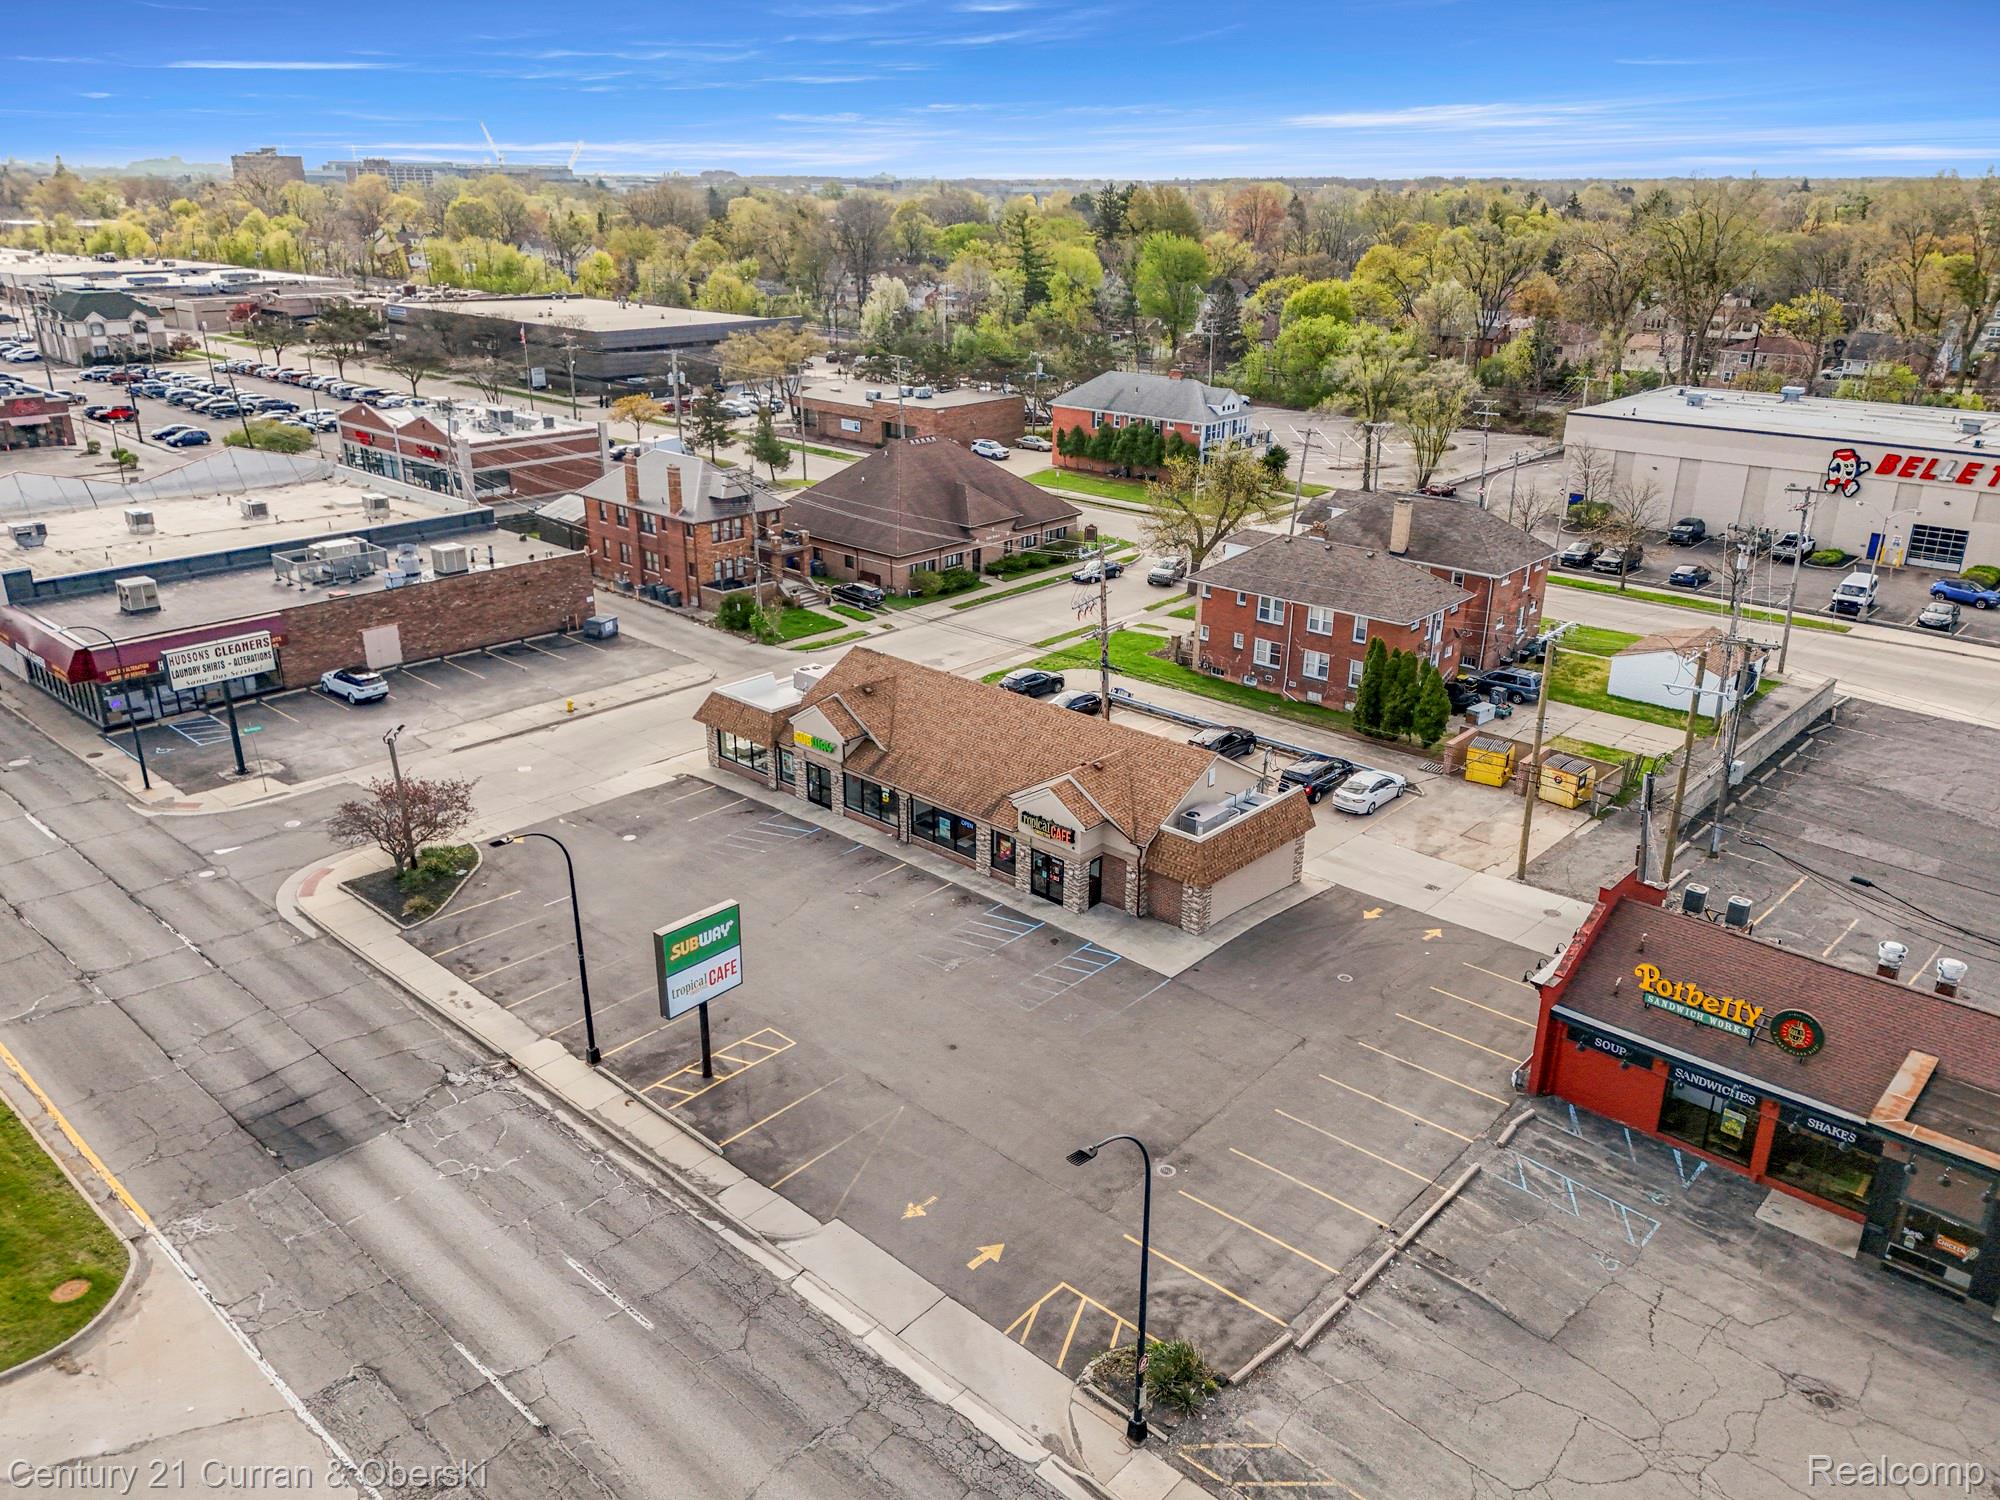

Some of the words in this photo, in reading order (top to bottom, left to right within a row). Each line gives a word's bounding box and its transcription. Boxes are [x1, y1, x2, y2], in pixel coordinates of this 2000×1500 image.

[1875, 453, 1985, 484] BELLE
[214, 637, 270, 658] CLEANERS
[171, 667, 201, 680] LAUNDRY
[202, 660, 226, 674] SHIRTS
[233, 650, 273, 667] ALTERATIONS
[961, 819, 974, 829] OPEN
[1050, 825, 1073, 845] CAFE
[670, 919, 734, 961] SUBWAY
[671, 973, 707, 1000] tropical
[708, 958, 738, 986] CAFE
[1634, 962, 1763, 1028] Potbelly
[1647, 994, 1704, 1021] SANDWICH
[1709, 1015, 1749, 1036] WORKS
[1594, 1036, 1627, 1057] SOUP
[1674, 1067, 1757, 1106] SANDWICHES
[1807, 1117, 1857, 1143] SHAKES
